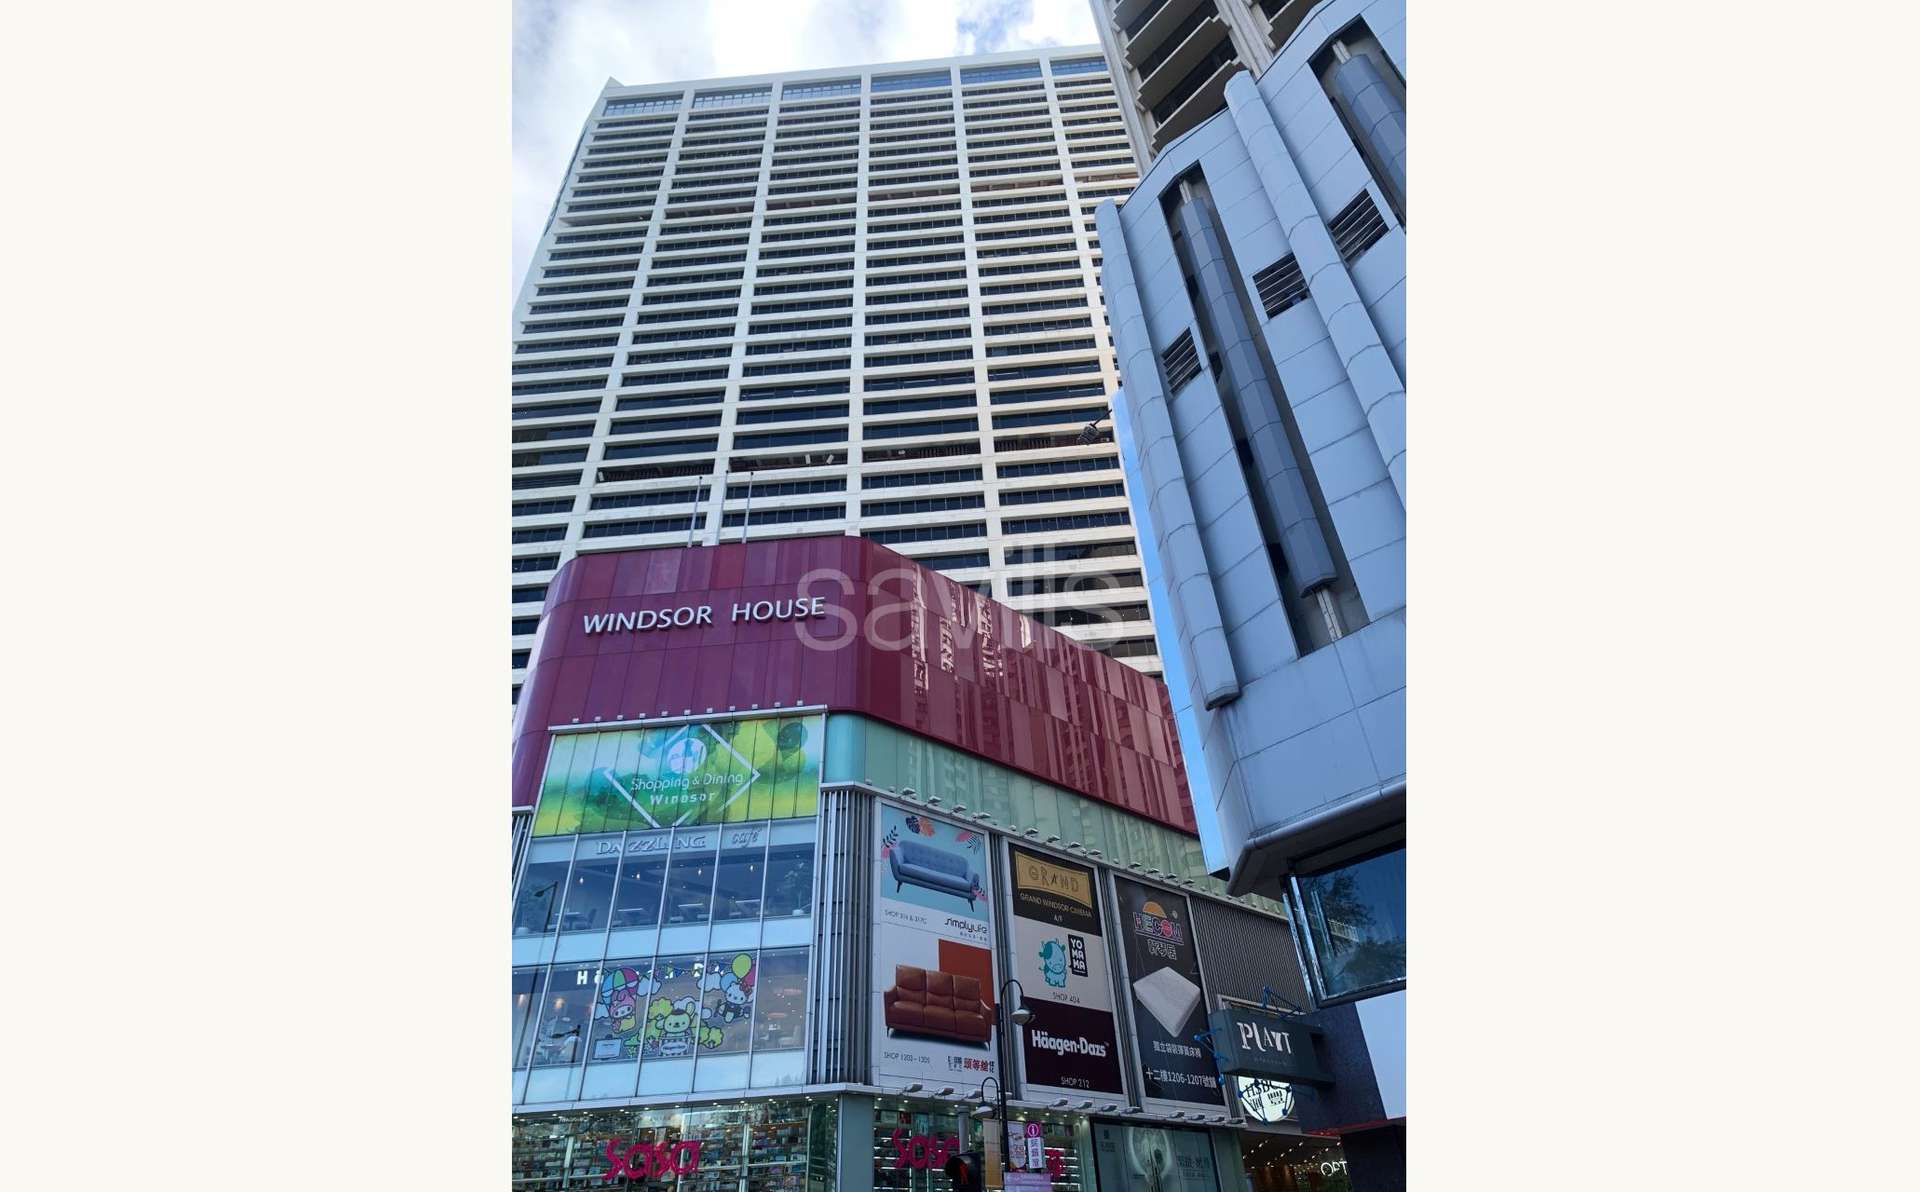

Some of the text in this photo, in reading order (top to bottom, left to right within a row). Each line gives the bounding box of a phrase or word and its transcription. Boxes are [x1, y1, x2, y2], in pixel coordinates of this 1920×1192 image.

[583, 597, 826, 634] WINDSOR HOUSE
[631, 772, 744, 791] Shopping & Dining
[1070, 938, 1083, 949] YO
[1032, 1029, 1107, 1057] Häagen-Dazs
[1060, 1076, 1077, 1086] SHOP
